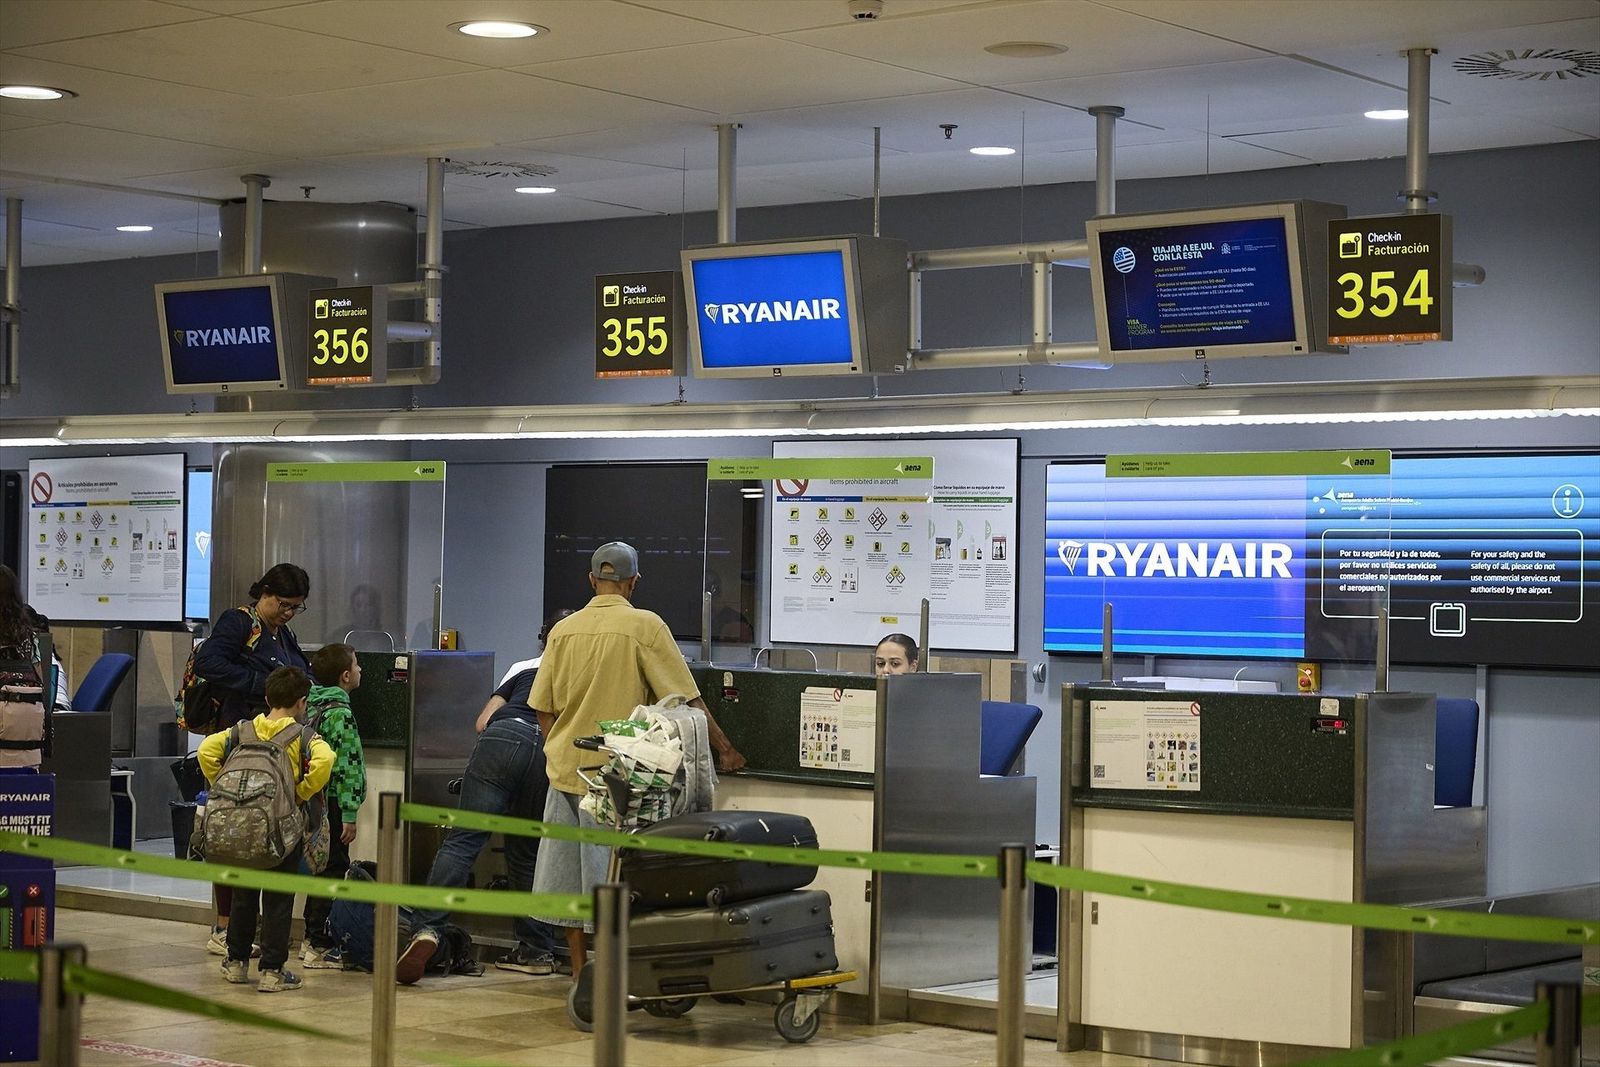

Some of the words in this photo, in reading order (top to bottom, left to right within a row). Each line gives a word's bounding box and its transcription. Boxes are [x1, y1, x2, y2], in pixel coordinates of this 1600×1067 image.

[1367, 232, 1401, 243] Check-in
[1152, 243, 1181, 254] VIAJAR
[1182, 243, 1189, 252] A
[1190, 242, 1215, 251] EE.UU.
[1368, 243, 1429, 256] Facturación
[1153, 253, 1171, 262] CON
[1172, 253, 1182, 261] LA
[1184, 251, 1203, 260] ESTA
[623, 285, 647, 294] Check-in
[1336, 269, 1434, 319] 354
[332, 299, 351, 308] Check-in
[623, 294, 666, 306] Facturación
[332, 308, 367, 318] Facturación
[722, 298, 841, 325] RYANAIR
[186, 326, 272, 347] RYANAIR
[602, 316, 668, 357] 355
[312, 327, 369, 365] 356
[1354, 458, 1374, 466] aena
[904, 464, 921, 472] aena
[1361, 550, 1395, 558] seguridad
[1499, 551, 1519, 559] safety
[1087, 542, 1293, 578] RYANAIR
[1340, 562, 1351, 570] por
[1471, 562, 1491, 571] safety
[1492, 562, 1500, 570] of
[1501, 563, 1510, 571] all,
[1511, 563, 1533, 571] please
[1389, 573, 1429, 581] autorizados
[1430, 574, 1442, 582] por
[1483, 574, 1520, 582] commercial
[1470, 586, 1505, 594] authorised
[1506, 586, 1515, 595] by
[1528, 587, 1552, 595] airport.
[10, 815, 35, 825] MUST
[37, 815, 51, 825] FIT
[30, 825, 51, 836] THE
